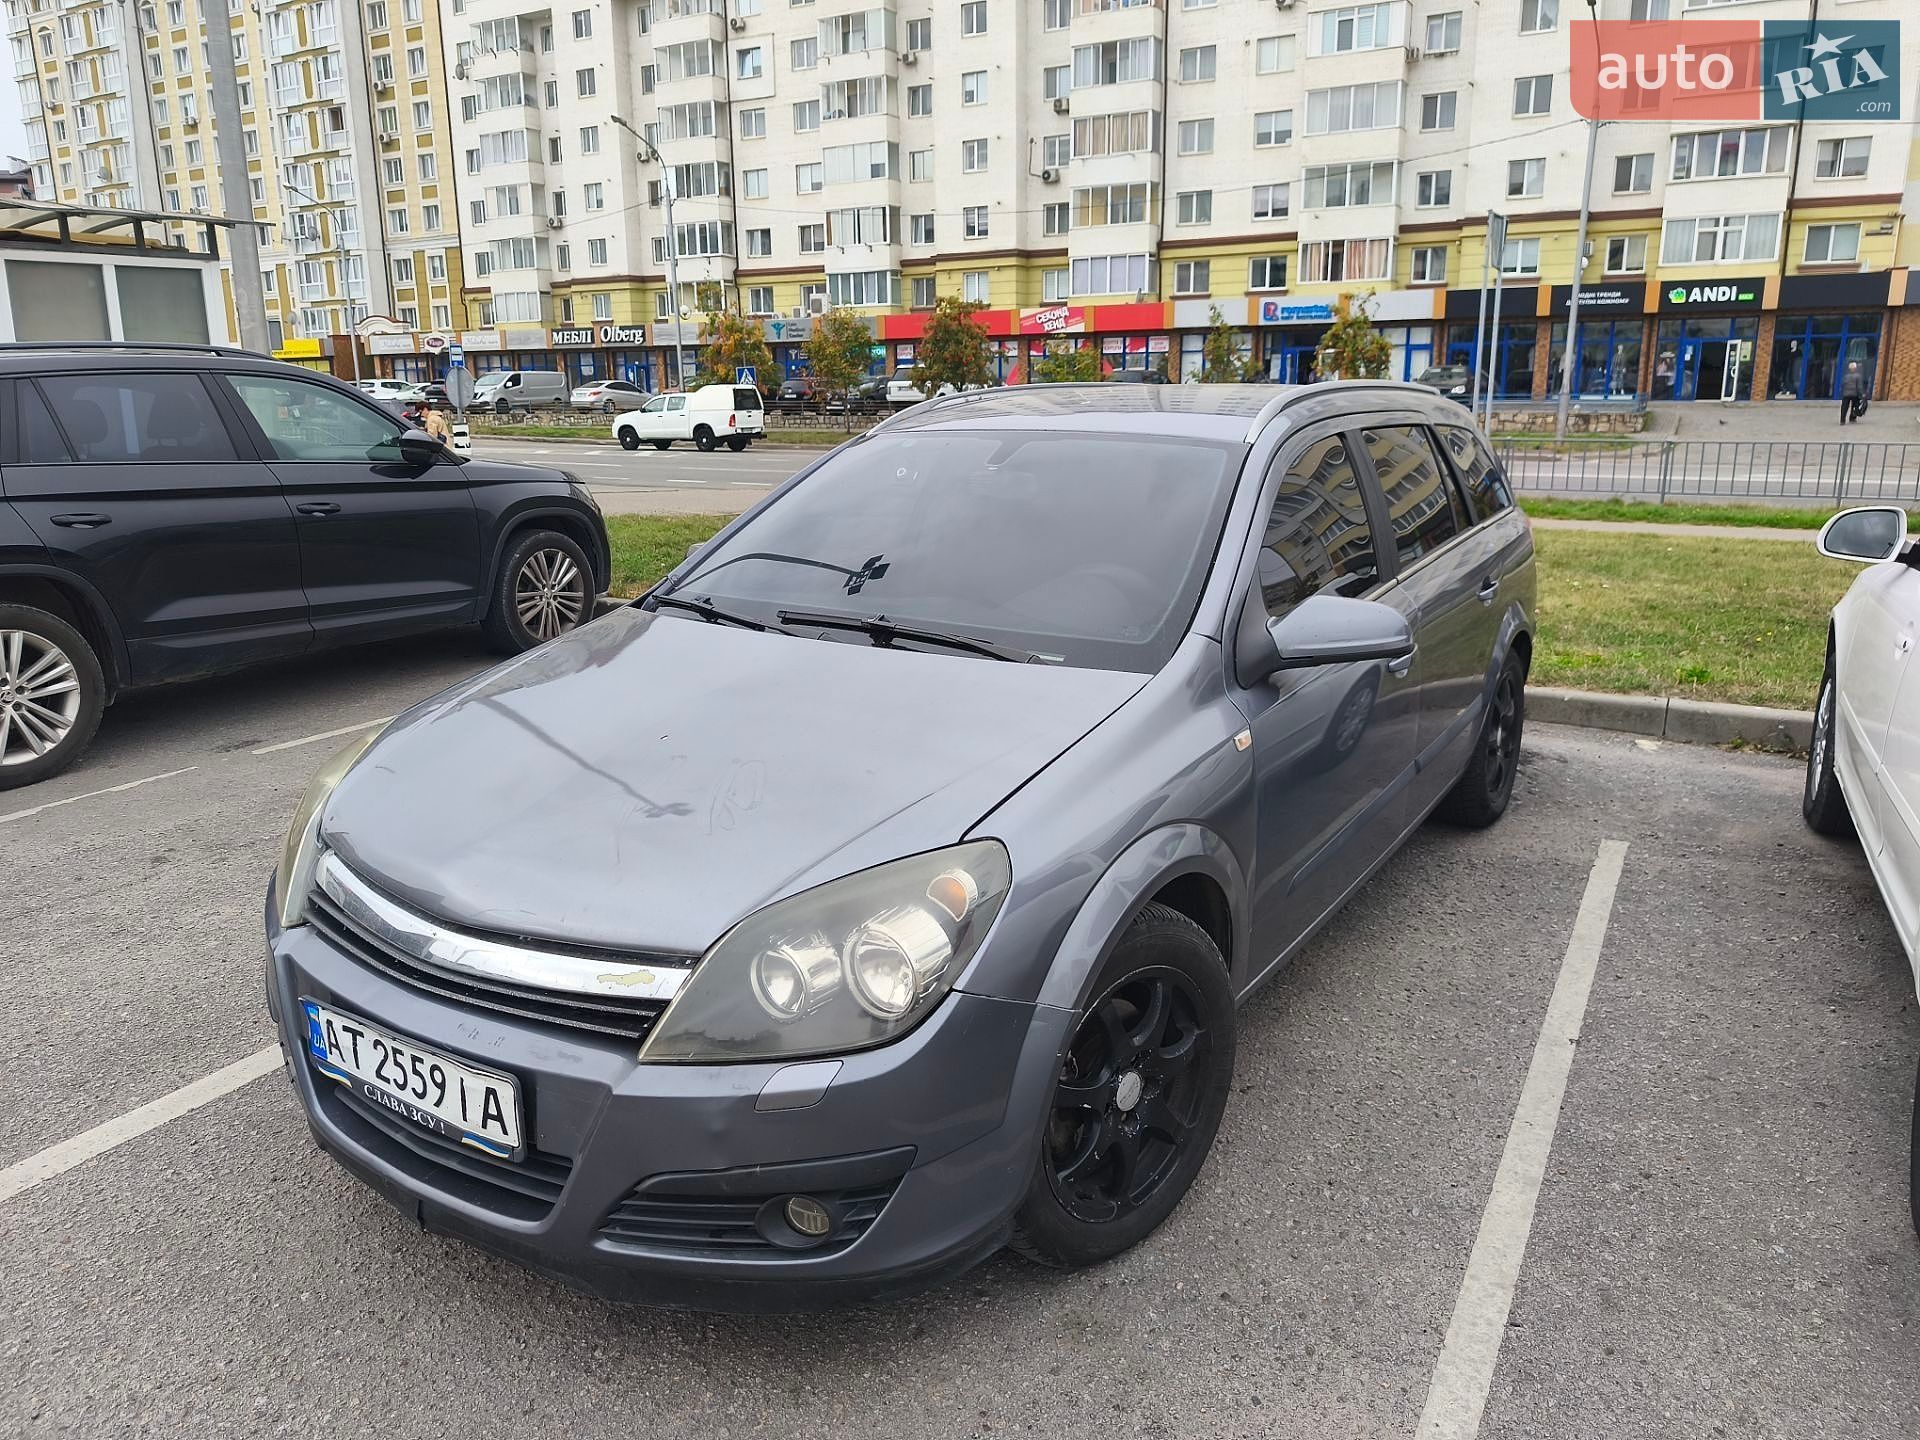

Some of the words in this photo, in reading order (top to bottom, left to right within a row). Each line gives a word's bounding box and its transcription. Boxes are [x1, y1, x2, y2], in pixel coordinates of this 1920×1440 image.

[1688, 286, 1737, 302] ANDI
[1036, 306, 1069, 323] СЕКОНД
[552, 330, 592, 344] МЕБЛІ
[600, 325, 644, 344] Olberg
[313, 1033, 326, 1048] UA
[326, 1018, 364, 1070] AT
[373, 1038, 446, 1108] 2559
[460, 1077, 508, 1136] IA
[363, 1084, 409, 1117] СЛАВА
[410, 1107, 436, 1129] ЗСУ
